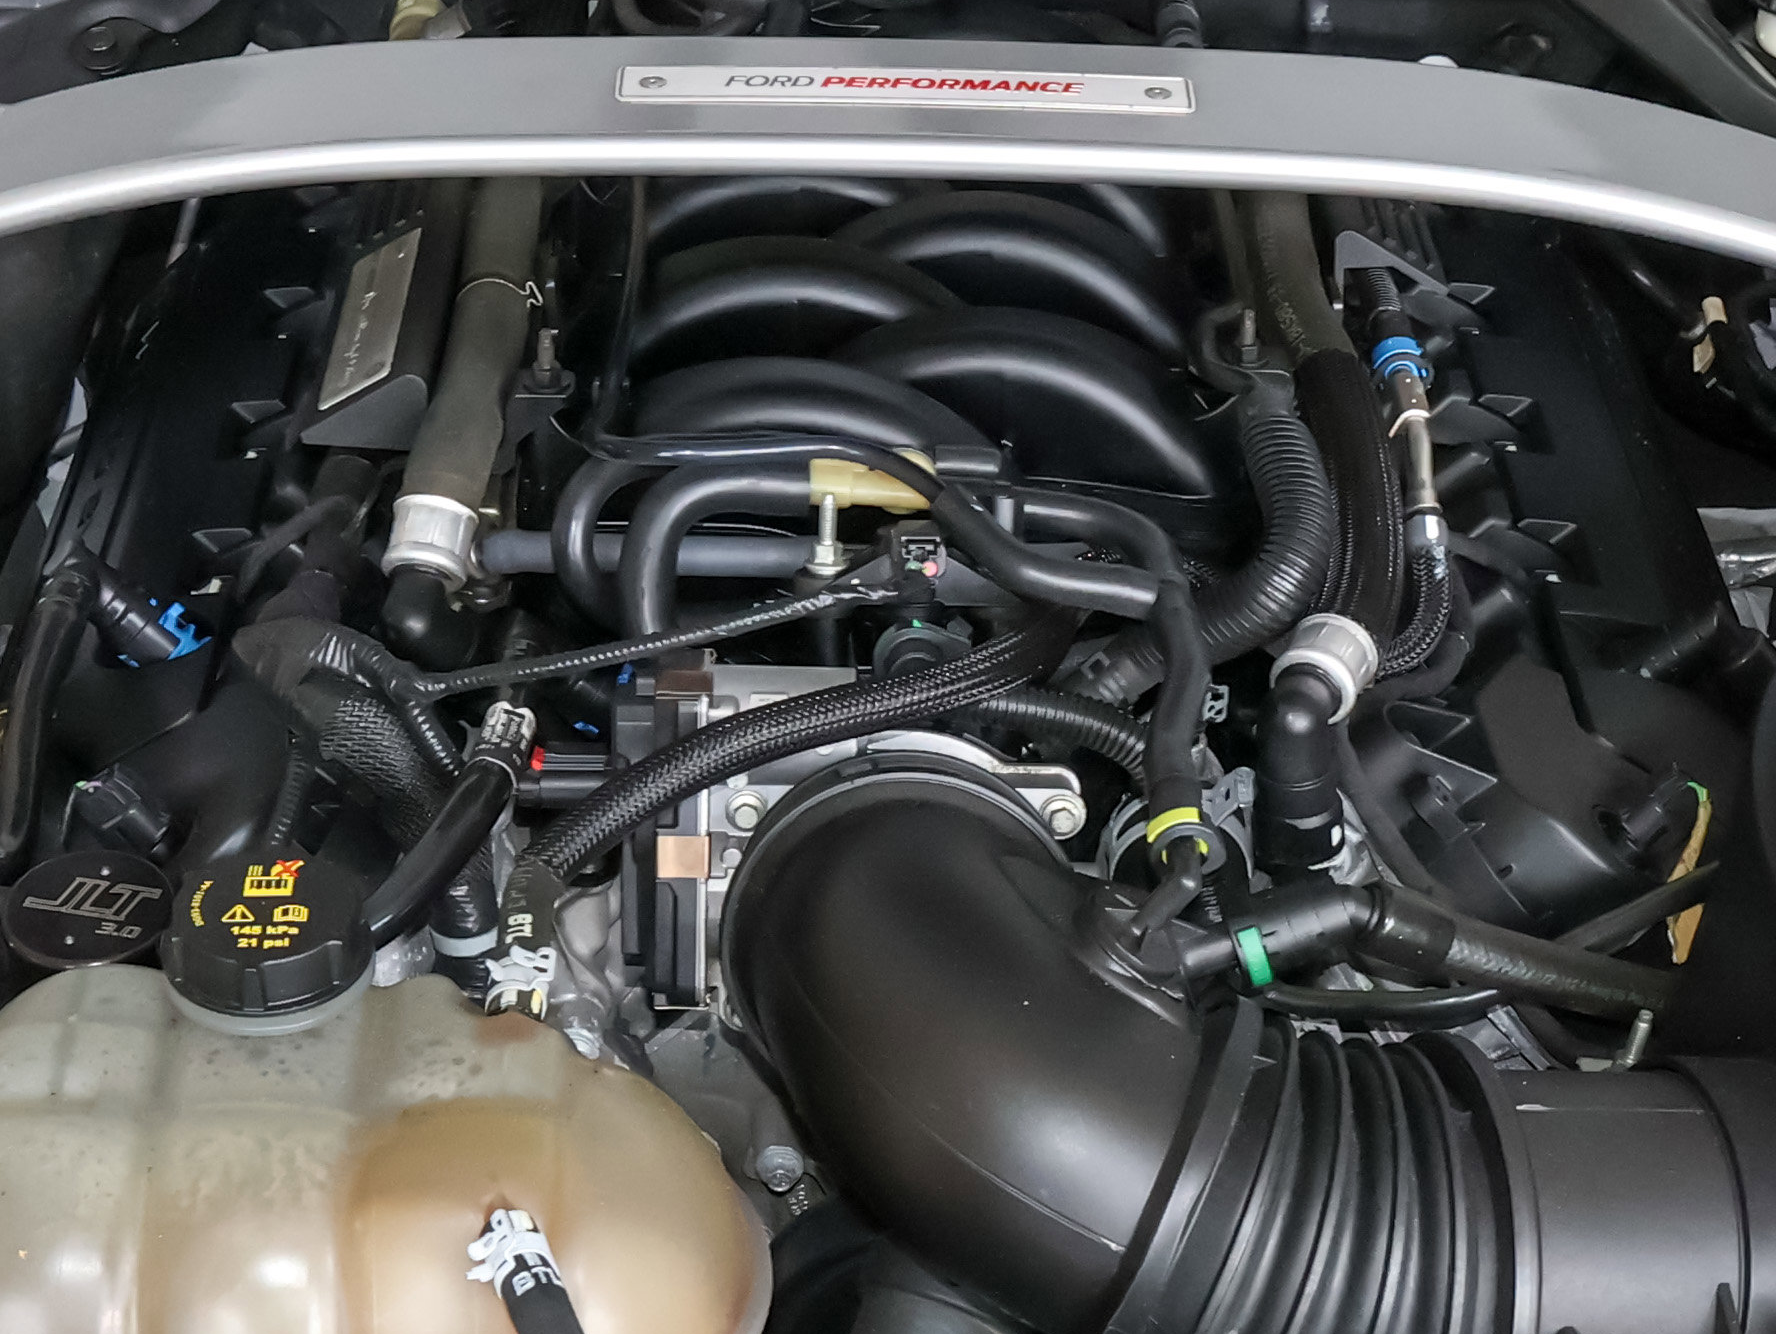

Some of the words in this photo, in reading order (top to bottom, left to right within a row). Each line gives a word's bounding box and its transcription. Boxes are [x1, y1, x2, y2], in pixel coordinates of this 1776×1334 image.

[725, 74, 815, 88] FORD
[820, 75, 1086, 95] PERFORMANCE
[22, 876, 164, 922] JLT
[94, 921, 143, 939] 3.0
[229, 925, 263, 936] 145
[265, 924, 300, 936] kPa
[236, 937, 258, 948] 21
[262, 937, 291, 950] psi
